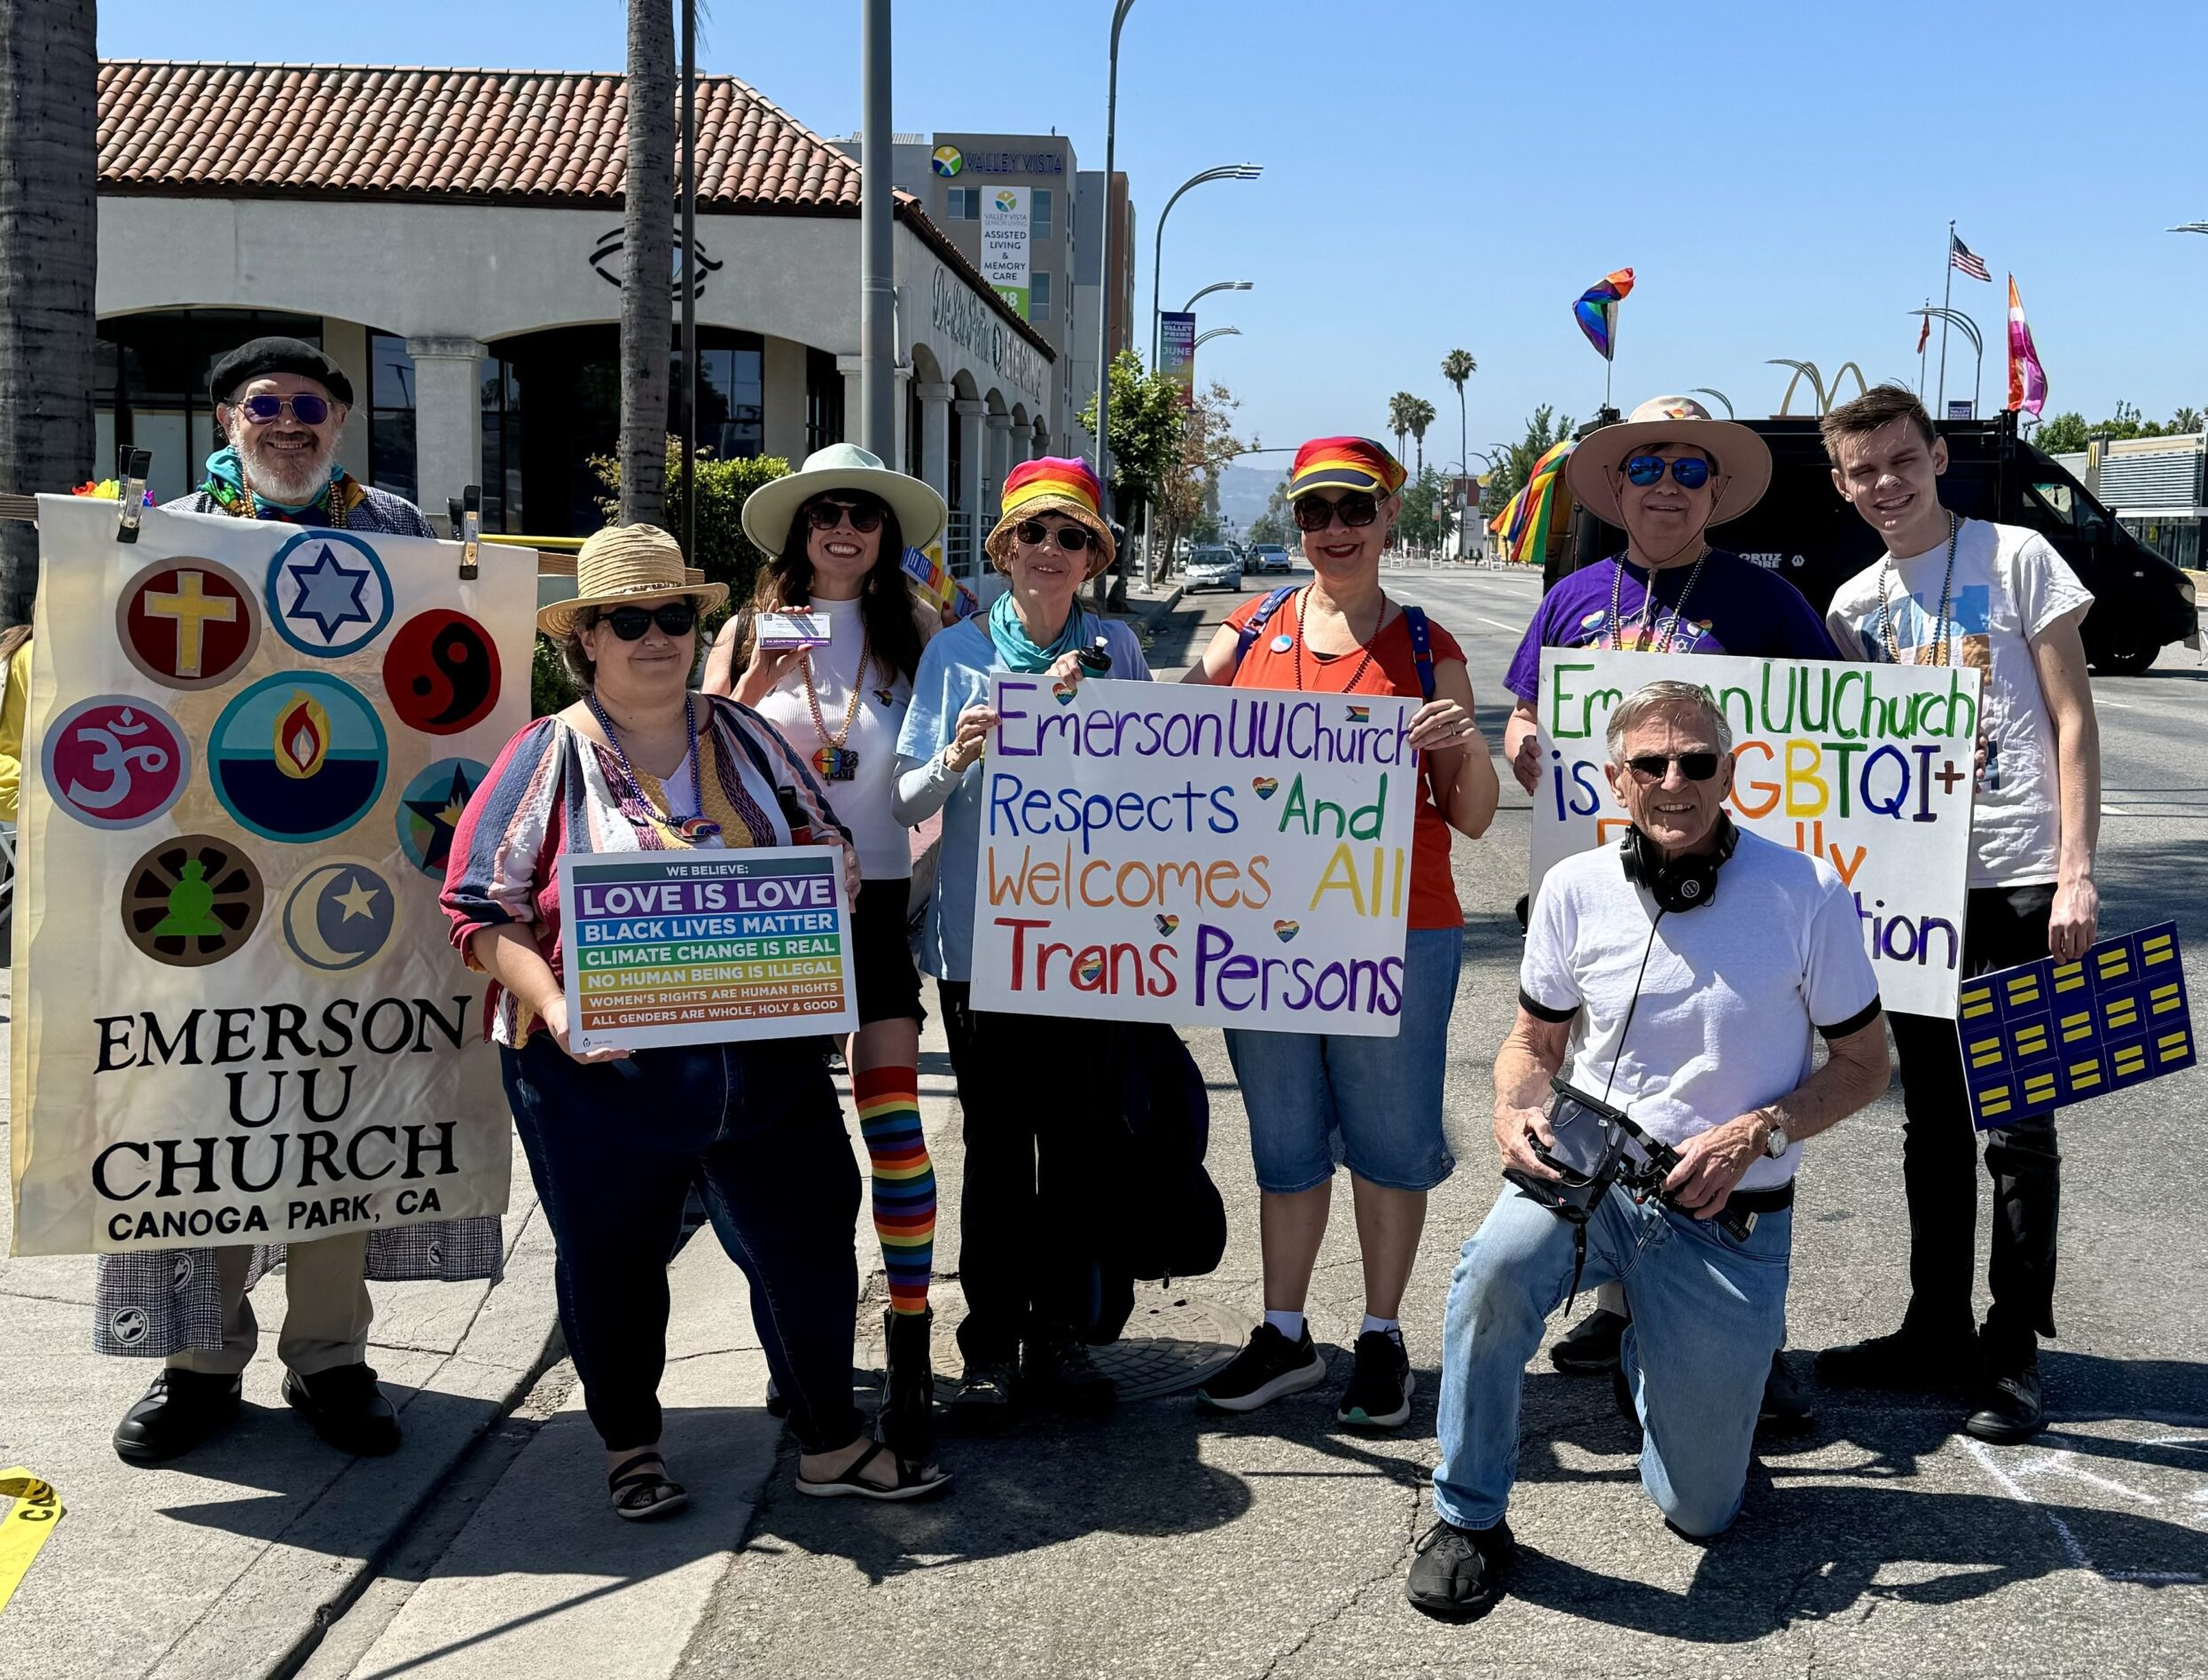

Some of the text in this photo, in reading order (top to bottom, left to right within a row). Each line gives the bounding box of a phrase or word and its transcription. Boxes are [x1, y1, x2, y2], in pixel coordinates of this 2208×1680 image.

[966, 152, 1062, 174] VALLEY VISTA
[984, 231, 1027, 239] ASSISTED
[984, 262, 1026, 270] MEMORY
[1163, 347, 1193, 356] JUNE
[1171, 357, 1184, 366] 29
[998, 682, 1222, 757] Emerson
[1552, 738, 1966, 823] is GBTQI+
[990, 772, 1388, 855] Respects And
[666, 864, 749, 878] WE BELIEVE:
[988, 838, 1405, 918] Welcomes All
[582, 879, 832, 916] LOVE IS LOVE
[584, 913, 834, 942] BLACK LIVES MATTER
[585, 938, 835, 966] CLIMATE CHANGE IS REAL
[587, 960, 836, 989] NO HUMAN BEING IS ILLEGAL
[994, 918, 1405, 1017] Trans Persons
[589, 981, 838, 1008] WOMEN'S RIGHTS ARE HUMAN RIGHTS
[591, 999, 839, 1026] ALL GENDERS ARE WHOLE, HOLY & GOOD
[92, 995, 473, 1074] EMERSON
[224, 1064, 357, 1129] UU
[91, 1121, 460, 1201] CHURCH
[107, 1186, 442, 1241] CANOGA PARK, CA
